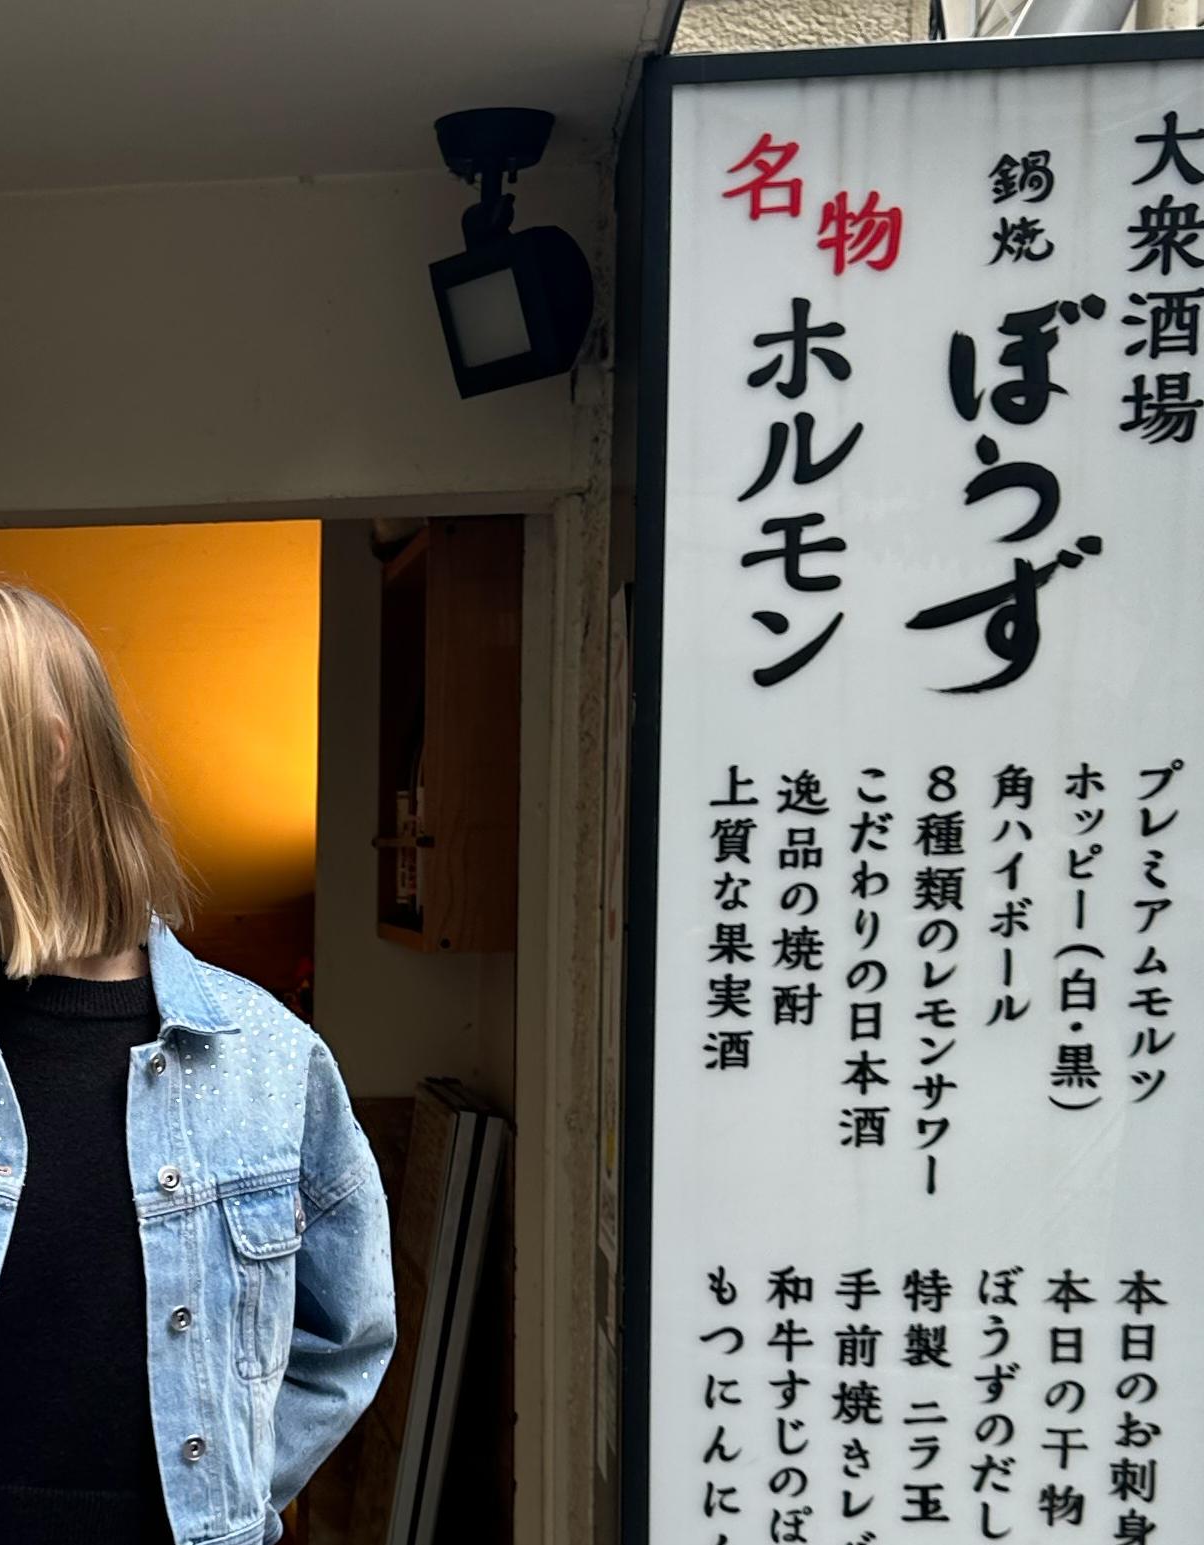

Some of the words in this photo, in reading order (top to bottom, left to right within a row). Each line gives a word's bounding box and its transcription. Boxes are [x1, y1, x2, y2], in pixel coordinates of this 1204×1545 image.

[723, 132, 902, 276] 名物
[987, 150, 1054, 265] 鍋焼
[1120, 111, 1204, 444] 大衆酒場
[738, 298, 863, 686] ホルモン
[905, 293, 1106, 695] ぼうず
[703, 765, 758, 1072] 上質な果実酒
[772, 769, 830, 1026] 逸品の焼酎
[839, 766, 894, 1148] こだわりの日本酒
[913, 765, 965, 1195] 8種類のレモンサワー
[985, 763, 1034, 1027] 角ハイボール
[1128, 759, 1184, 1103] プレミアムモルツ
[902, 1268, 952, 1367] 特製
[1038, 1269, 1096, 1527] 本日の干物
